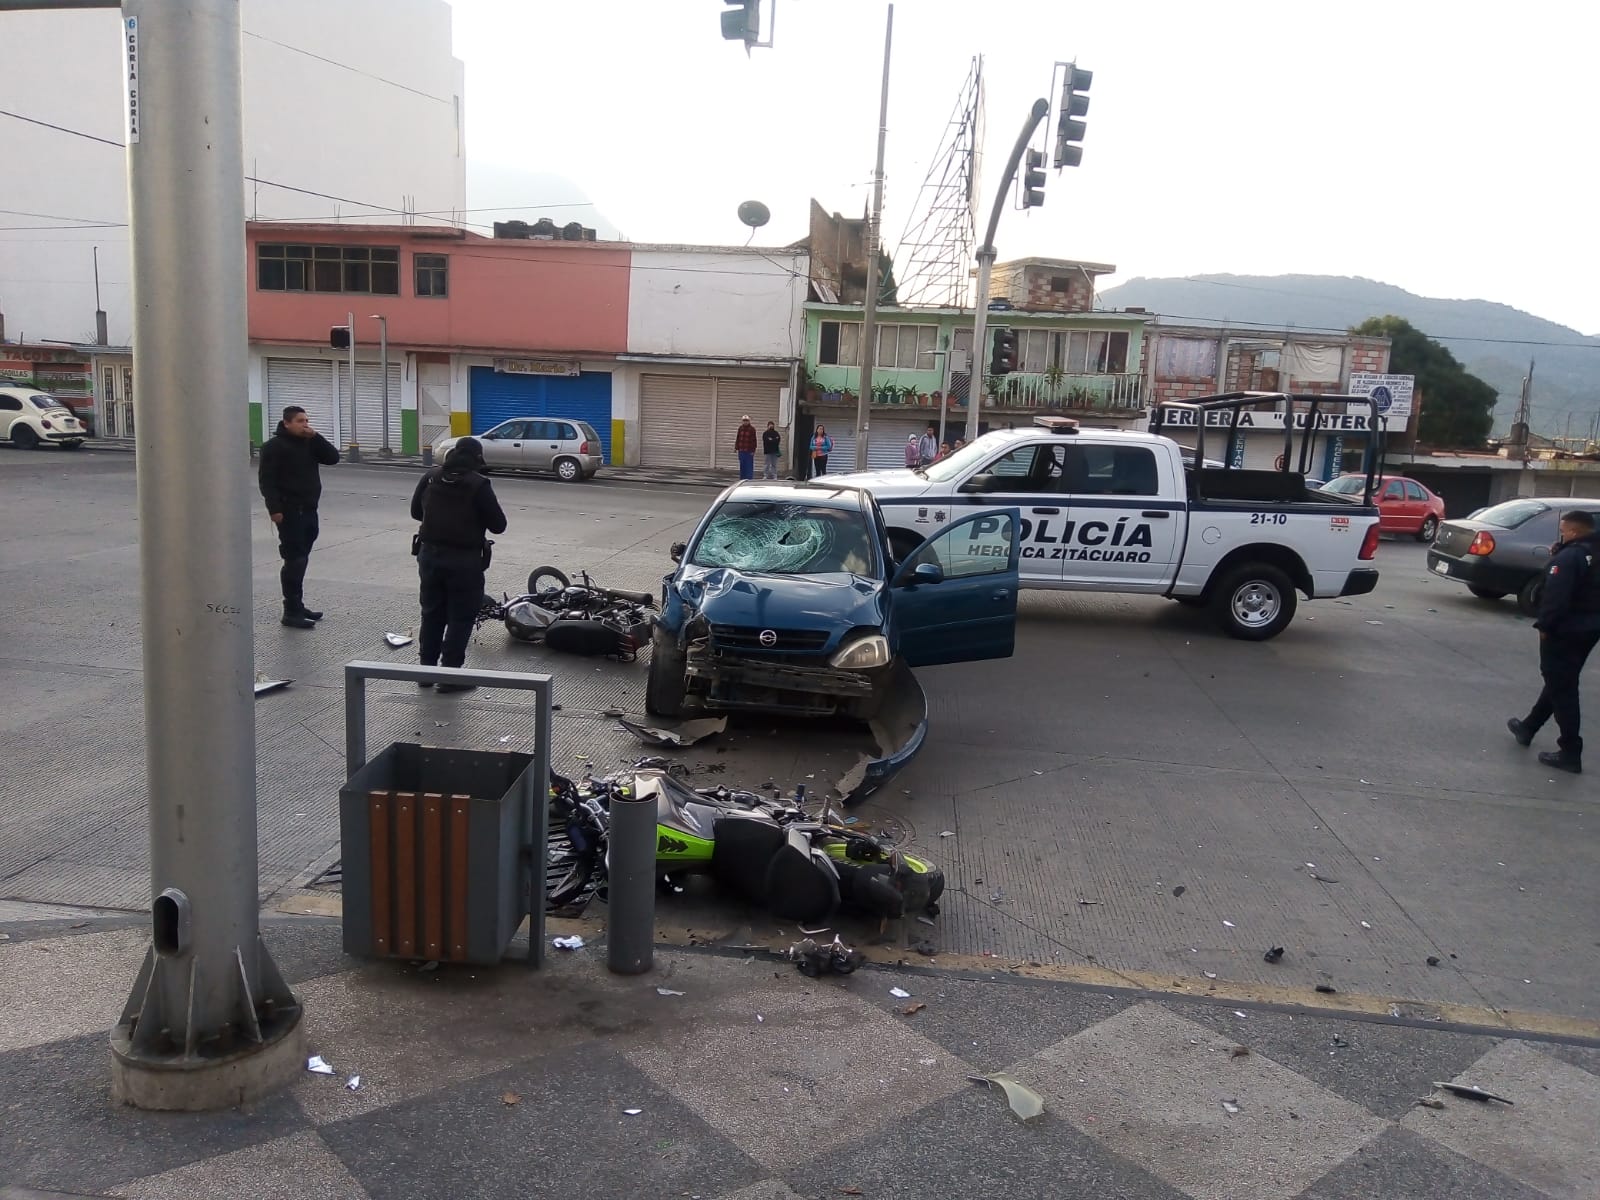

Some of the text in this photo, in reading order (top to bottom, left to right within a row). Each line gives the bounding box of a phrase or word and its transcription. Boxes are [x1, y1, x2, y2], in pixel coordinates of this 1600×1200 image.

[128, 34, 138, 135] CORIA CORIA
[1150, 409, 1254, 426] ERERA
[1250, 513, 1287, 525] 21-10
[969, 516, 1153, 548] POLICÍA
[967, 544, 1152, 563] HEROCA ZITÁCUARO
